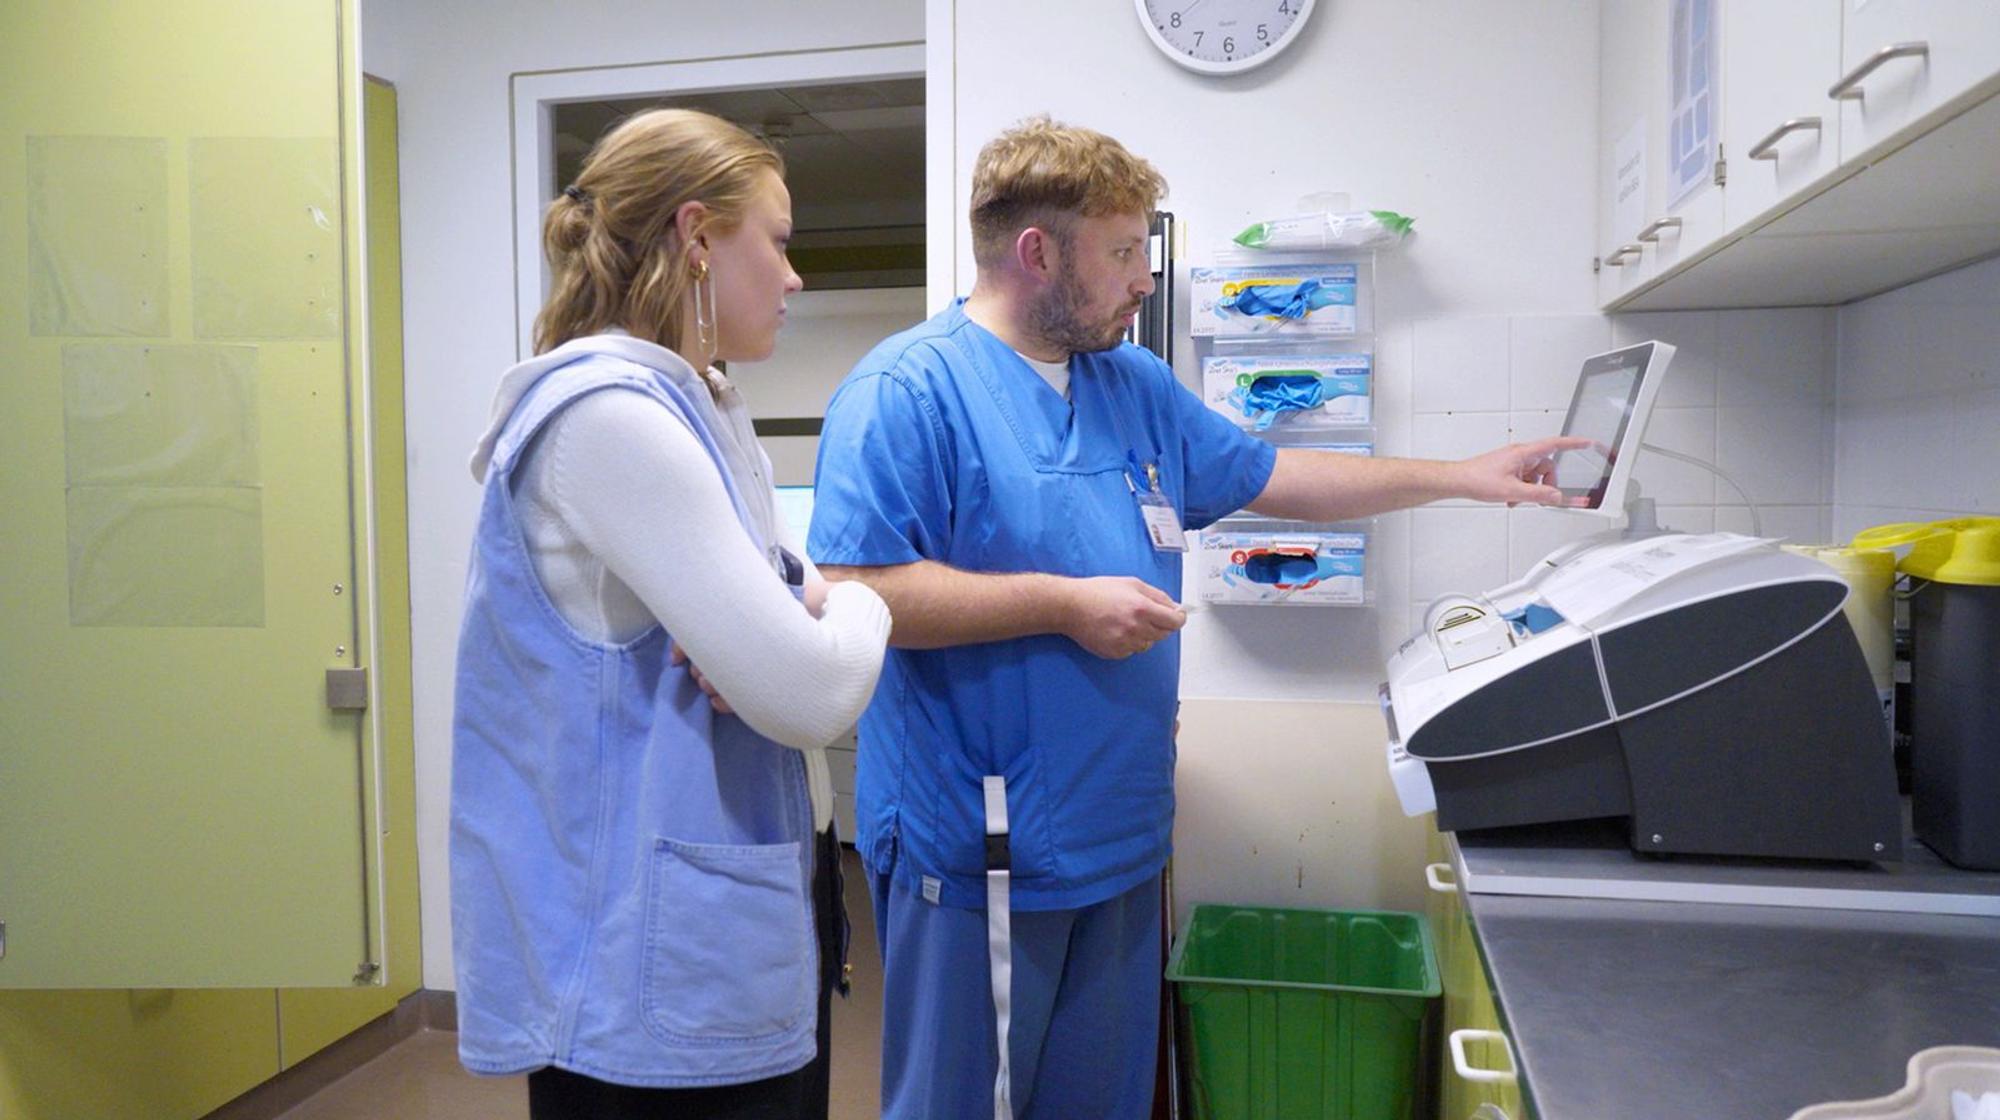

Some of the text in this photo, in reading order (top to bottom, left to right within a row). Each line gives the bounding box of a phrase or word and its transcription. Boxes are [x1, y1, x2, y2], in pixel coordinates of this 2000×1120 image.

[1279, 0, 1289, 15] 4
[1170, 12, 1181, 28] 8
[1194, 32, 1204, 47] 7
[1257, 24, 1267, 40] 5
[1224, 37, 1234, 53] 6
[1241, 377, 1247, 386] L
[1236, 553, 1244, 564] S
